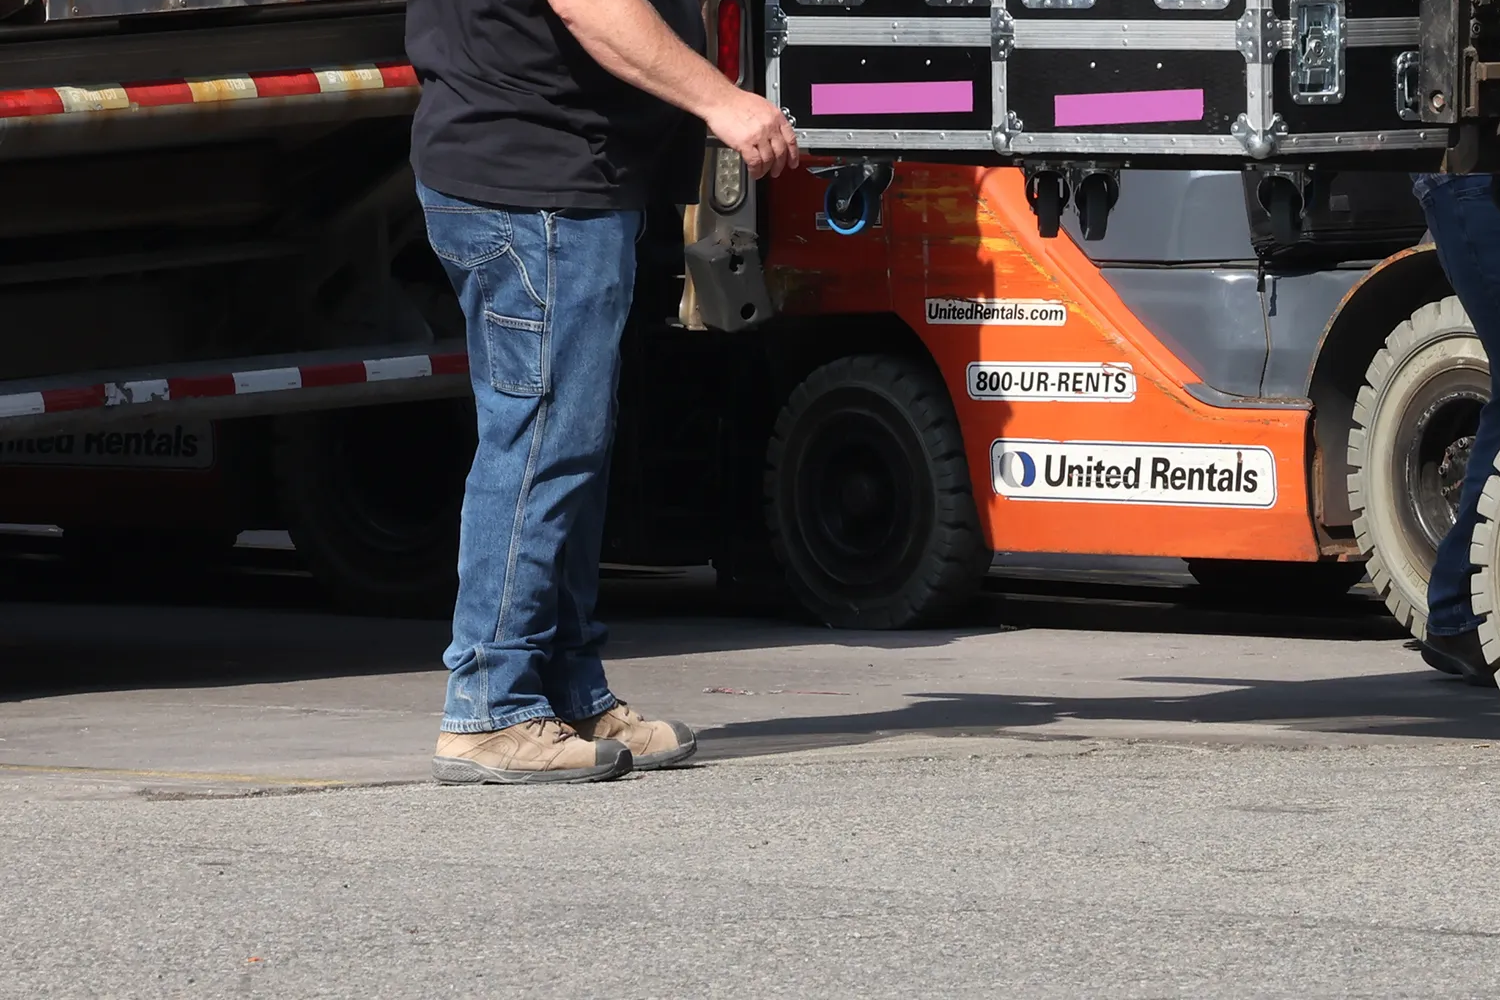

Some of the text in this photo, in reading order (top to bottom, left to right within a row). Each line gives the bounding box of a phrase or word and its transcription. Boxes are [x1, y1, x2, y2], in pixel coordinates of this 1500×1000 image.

[928, 303, 1064, 321] UnitedRentals.com
[975, 371, 1127, 393] 800-UR-RENTS
[85, 425, 198, 457] Rentals
[1045, 455, 1258, 493] United Rentals
